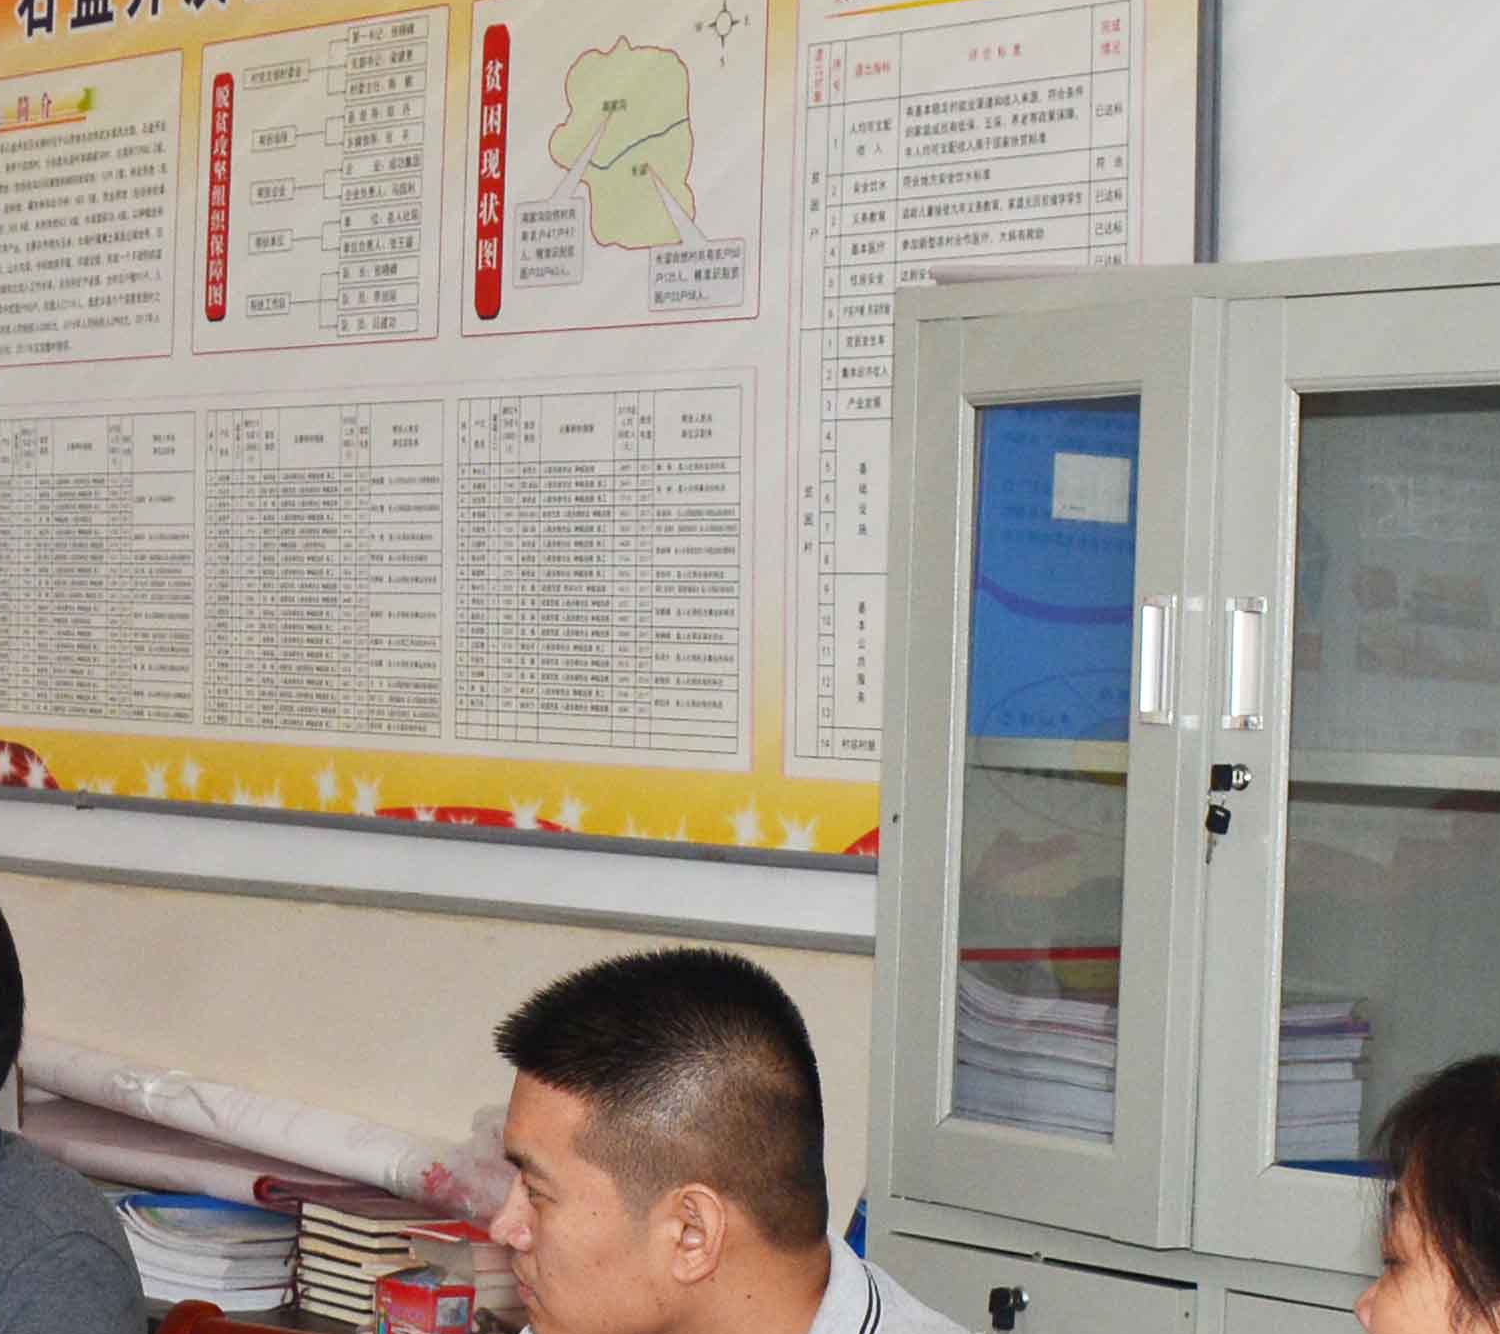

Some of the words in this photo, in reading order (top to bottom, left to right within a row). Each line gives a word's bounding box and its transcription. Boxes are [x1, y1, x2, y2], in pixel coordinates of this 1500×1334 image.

[477, 60, 503, 271] 贫困现状图
